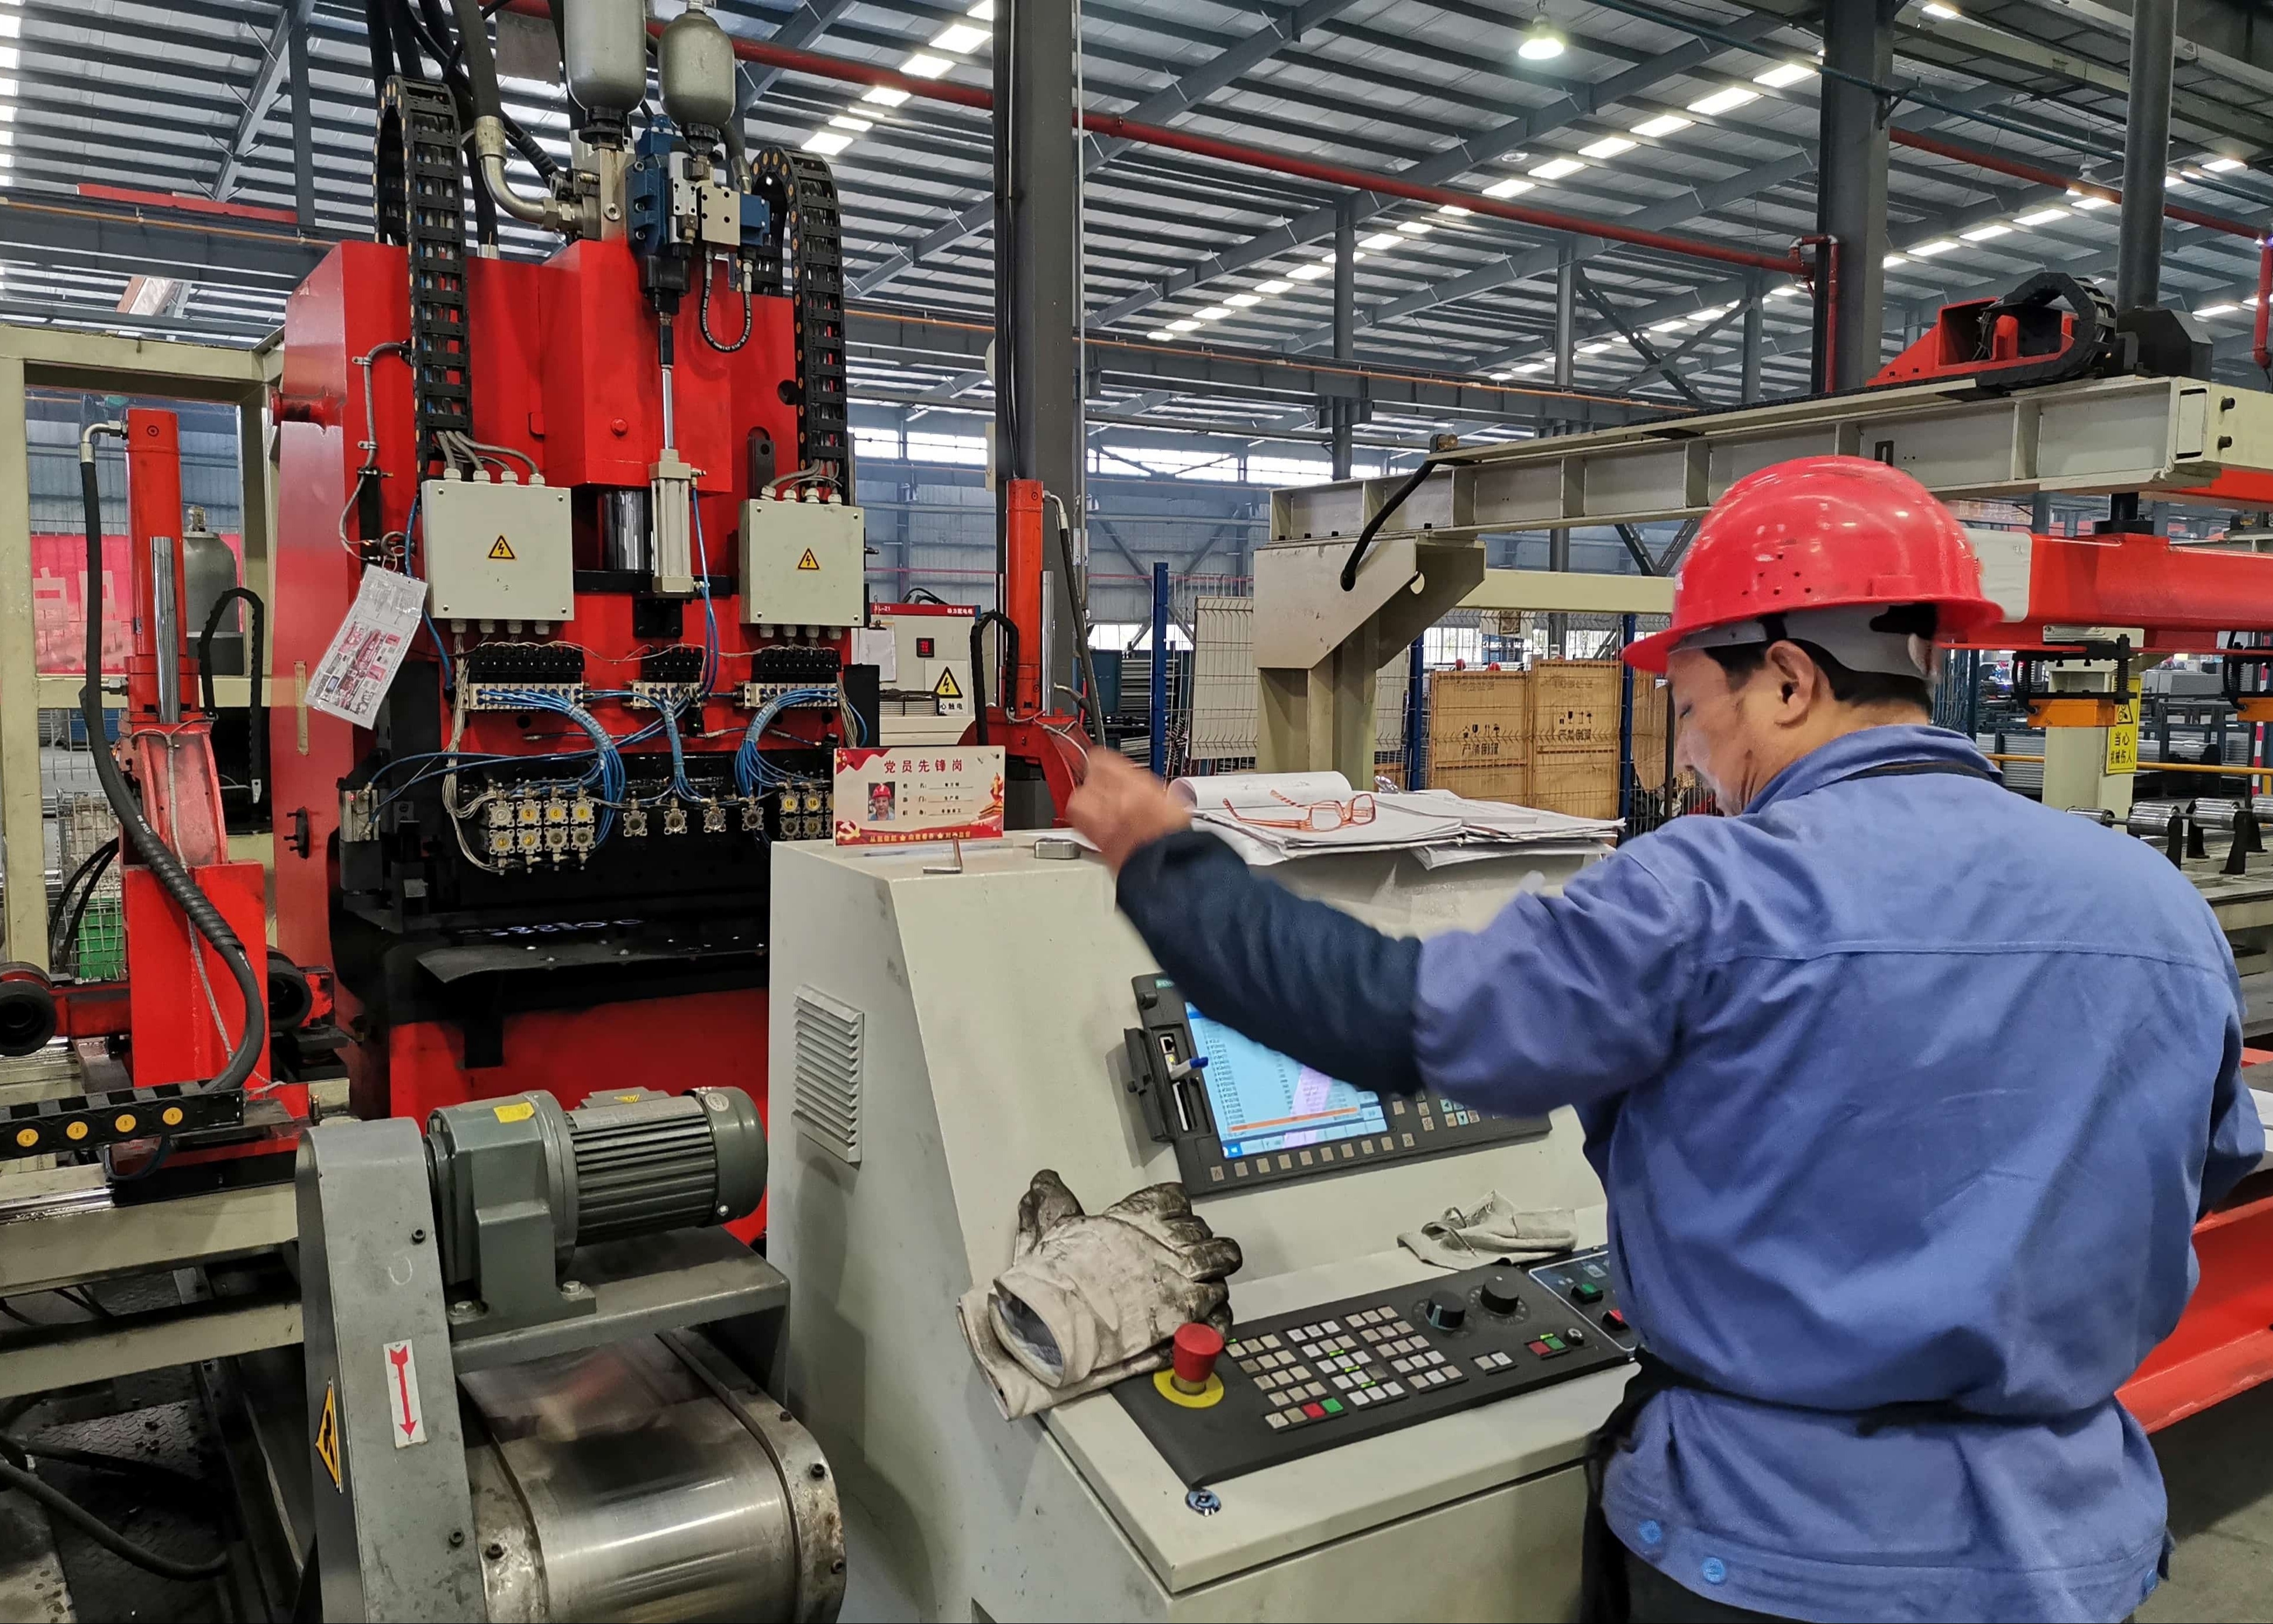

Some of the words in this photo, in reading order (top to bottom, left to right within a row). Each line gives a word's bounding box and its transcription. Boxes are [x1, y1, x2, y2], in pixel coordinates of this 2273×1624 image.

[2115, 731, 2130, 746] 当心
[2110, 749, 2133, 764] 机械伤人
[884, 758, 964, 773] 党员先锋岗
